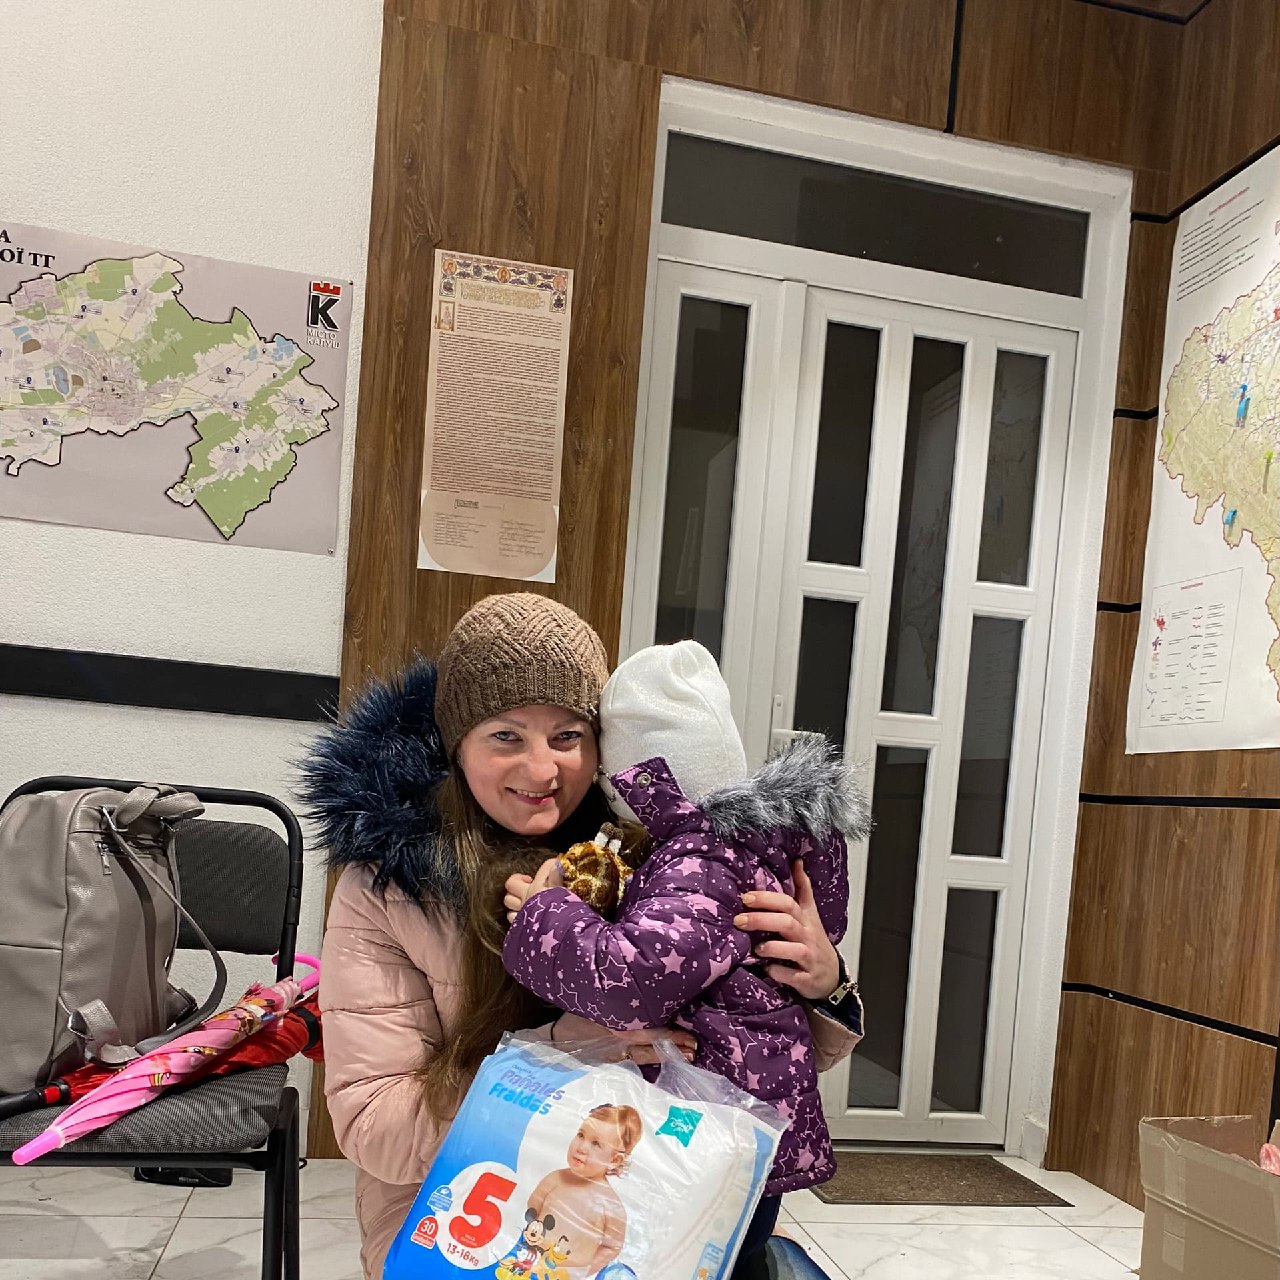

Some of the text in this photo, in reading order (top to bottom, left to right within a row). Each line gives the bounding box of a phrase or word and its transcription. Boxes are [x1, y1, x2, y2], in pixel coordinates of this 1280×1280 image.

[28, 252, 56, 268] ТГ
[448, 1171, 518, 1250] 5
[420, 1220, 436, 1235] 30
